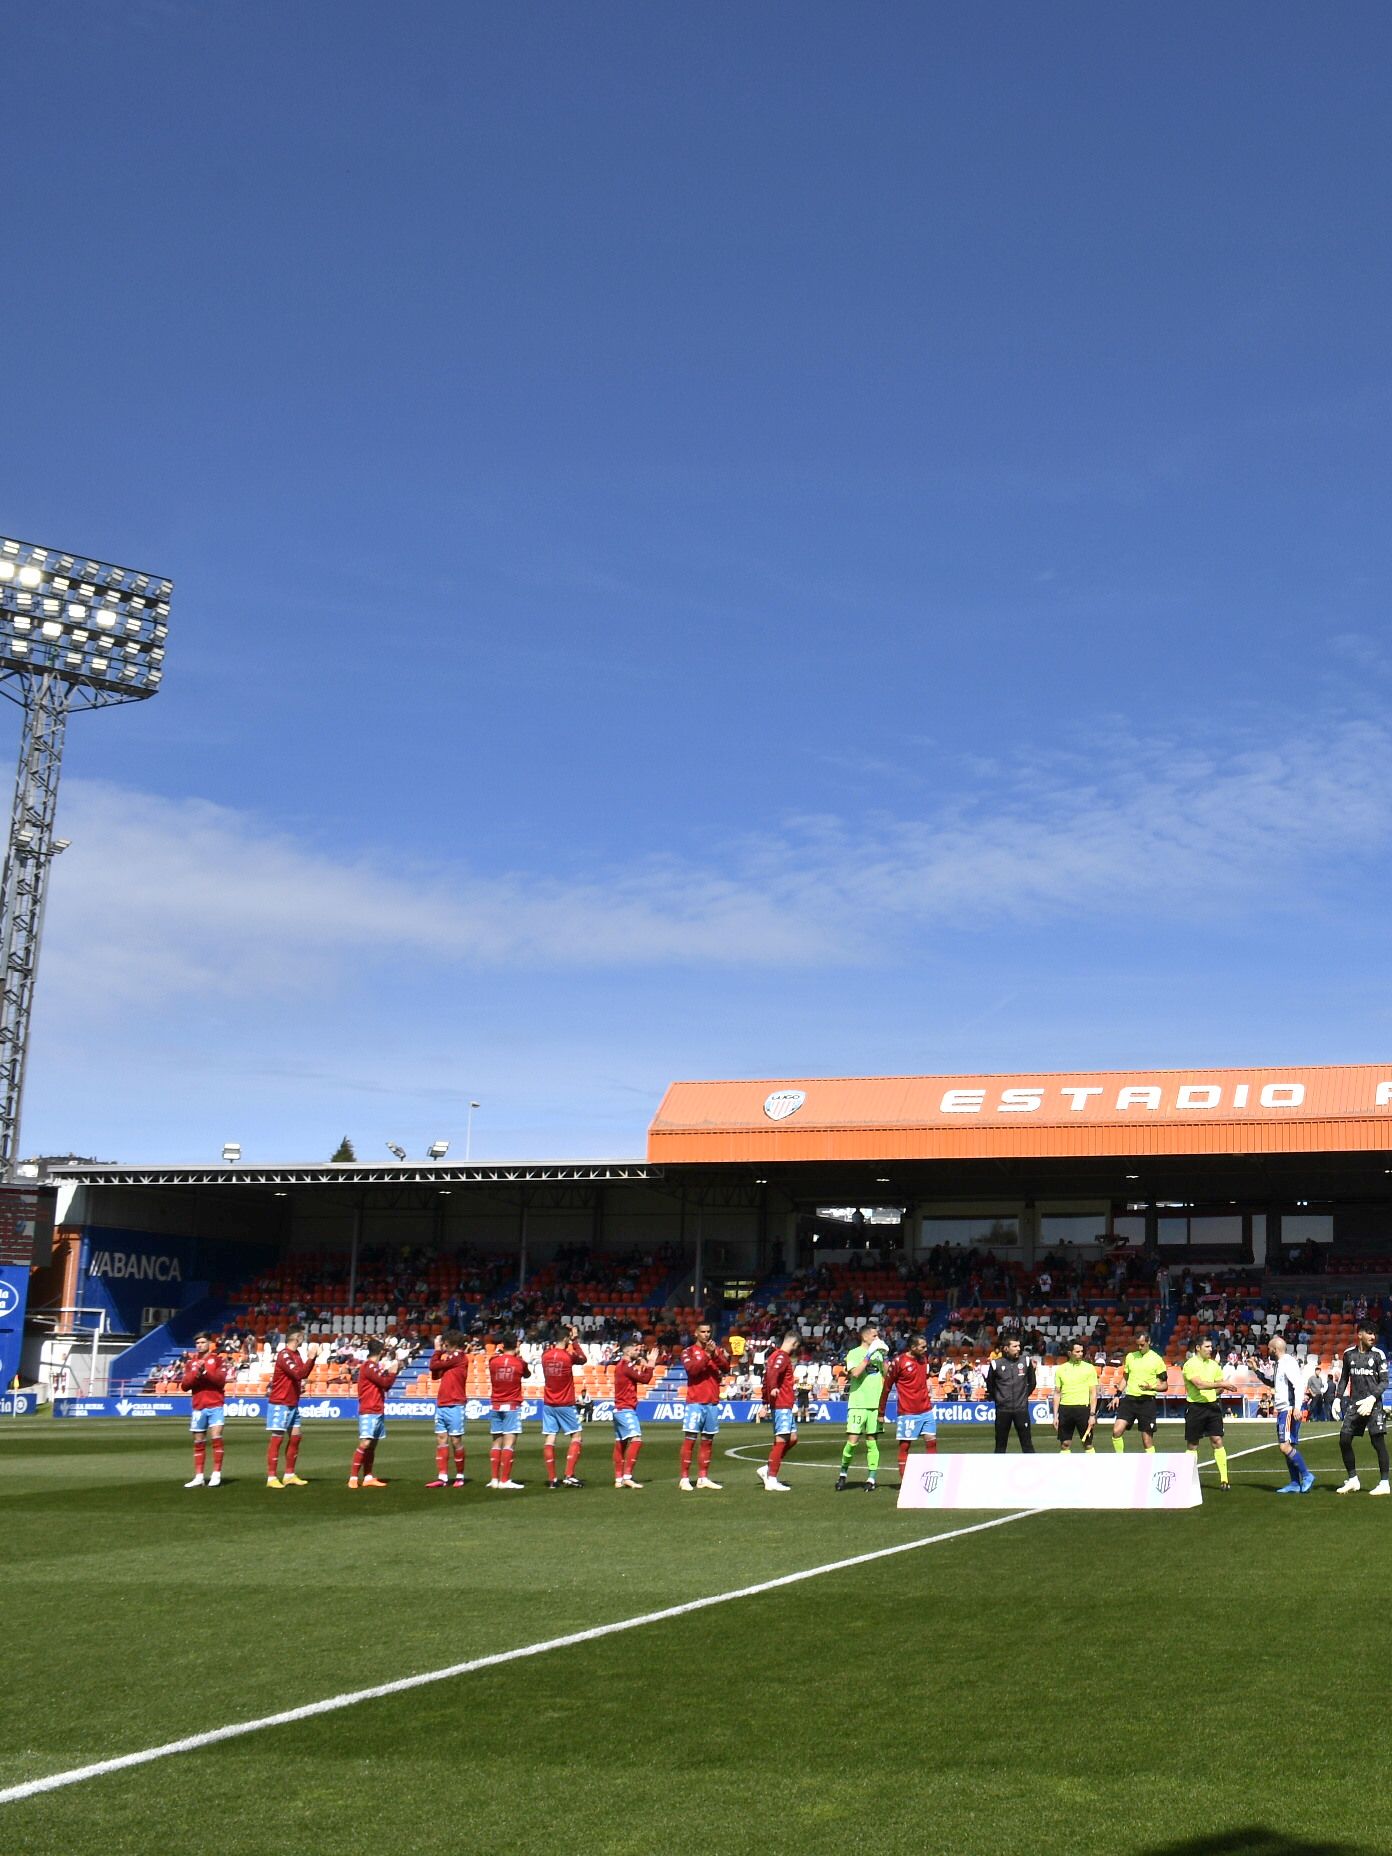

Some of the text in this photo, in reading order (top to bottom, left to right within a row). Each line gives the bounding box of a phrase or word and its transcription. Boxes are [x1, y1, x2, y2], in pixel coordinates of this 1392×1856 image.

[939, 1083, 1305, 1113] ESTADIO
[384, 1402, 436, 1416] ROGRESO
[931, 1403, 973, 1421] trella
[852, 1414, 862, 1425] 13
[904, 1419, 915, 1431] 14
